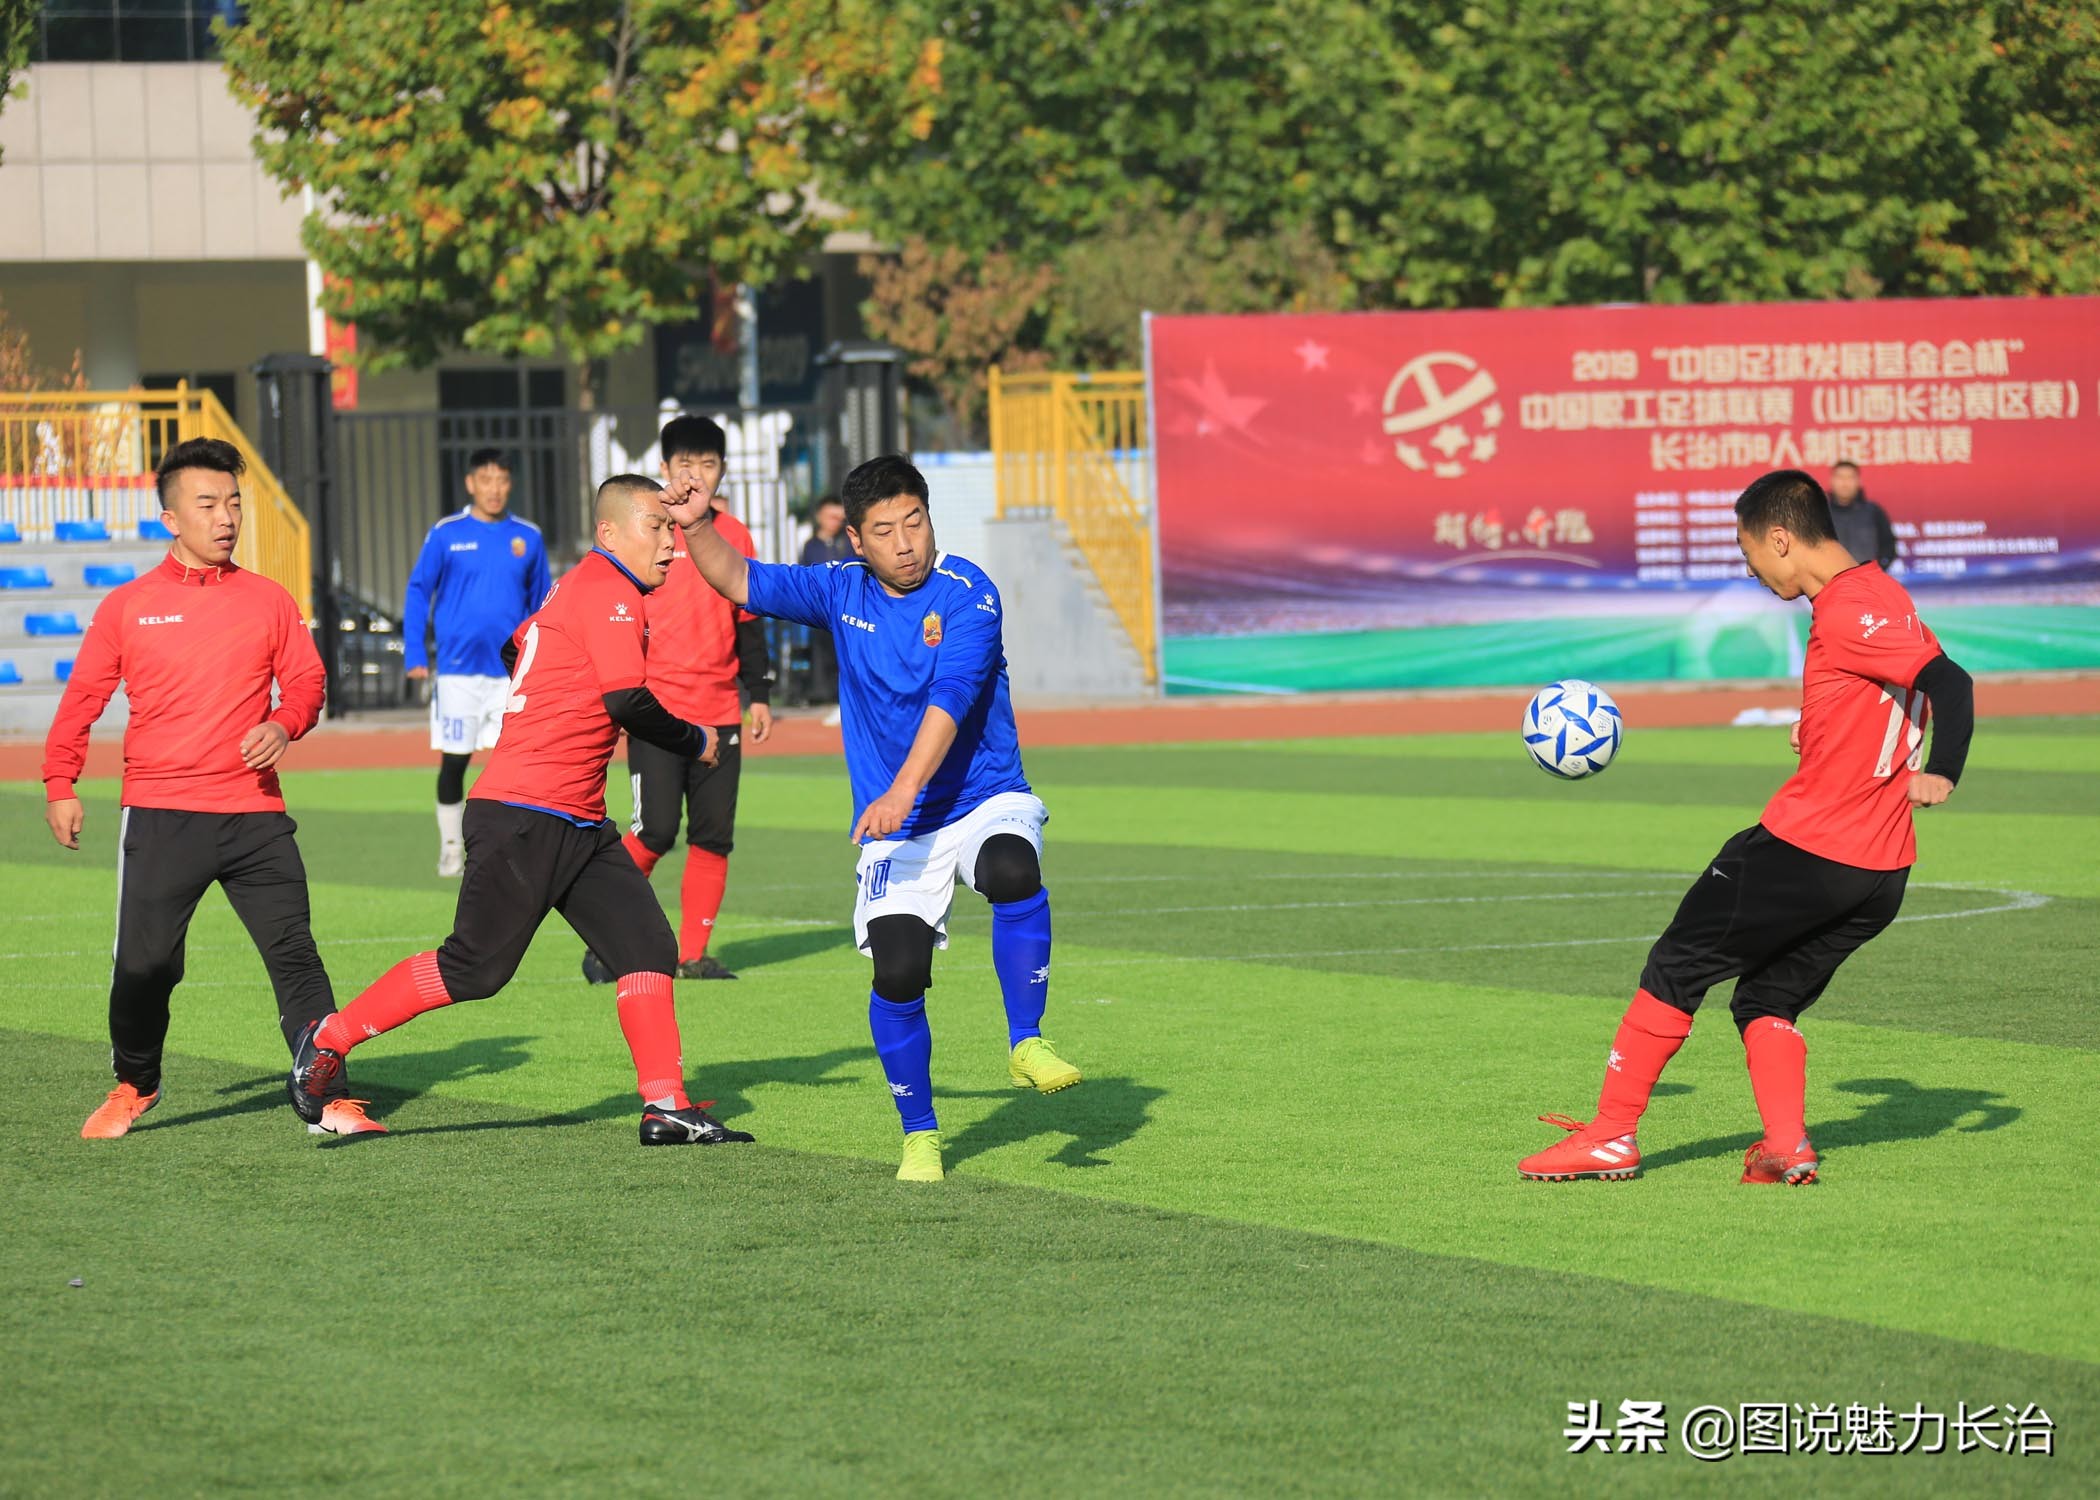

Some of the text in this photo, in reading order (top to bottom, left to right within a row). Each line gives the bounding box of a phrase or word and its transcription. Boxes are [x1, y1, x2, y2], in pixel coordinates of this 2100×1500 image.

[1572, 349, 1639, 381] 2019
[138, 614, 184, 625] KELME
[442, 716, 464, 741] 20
